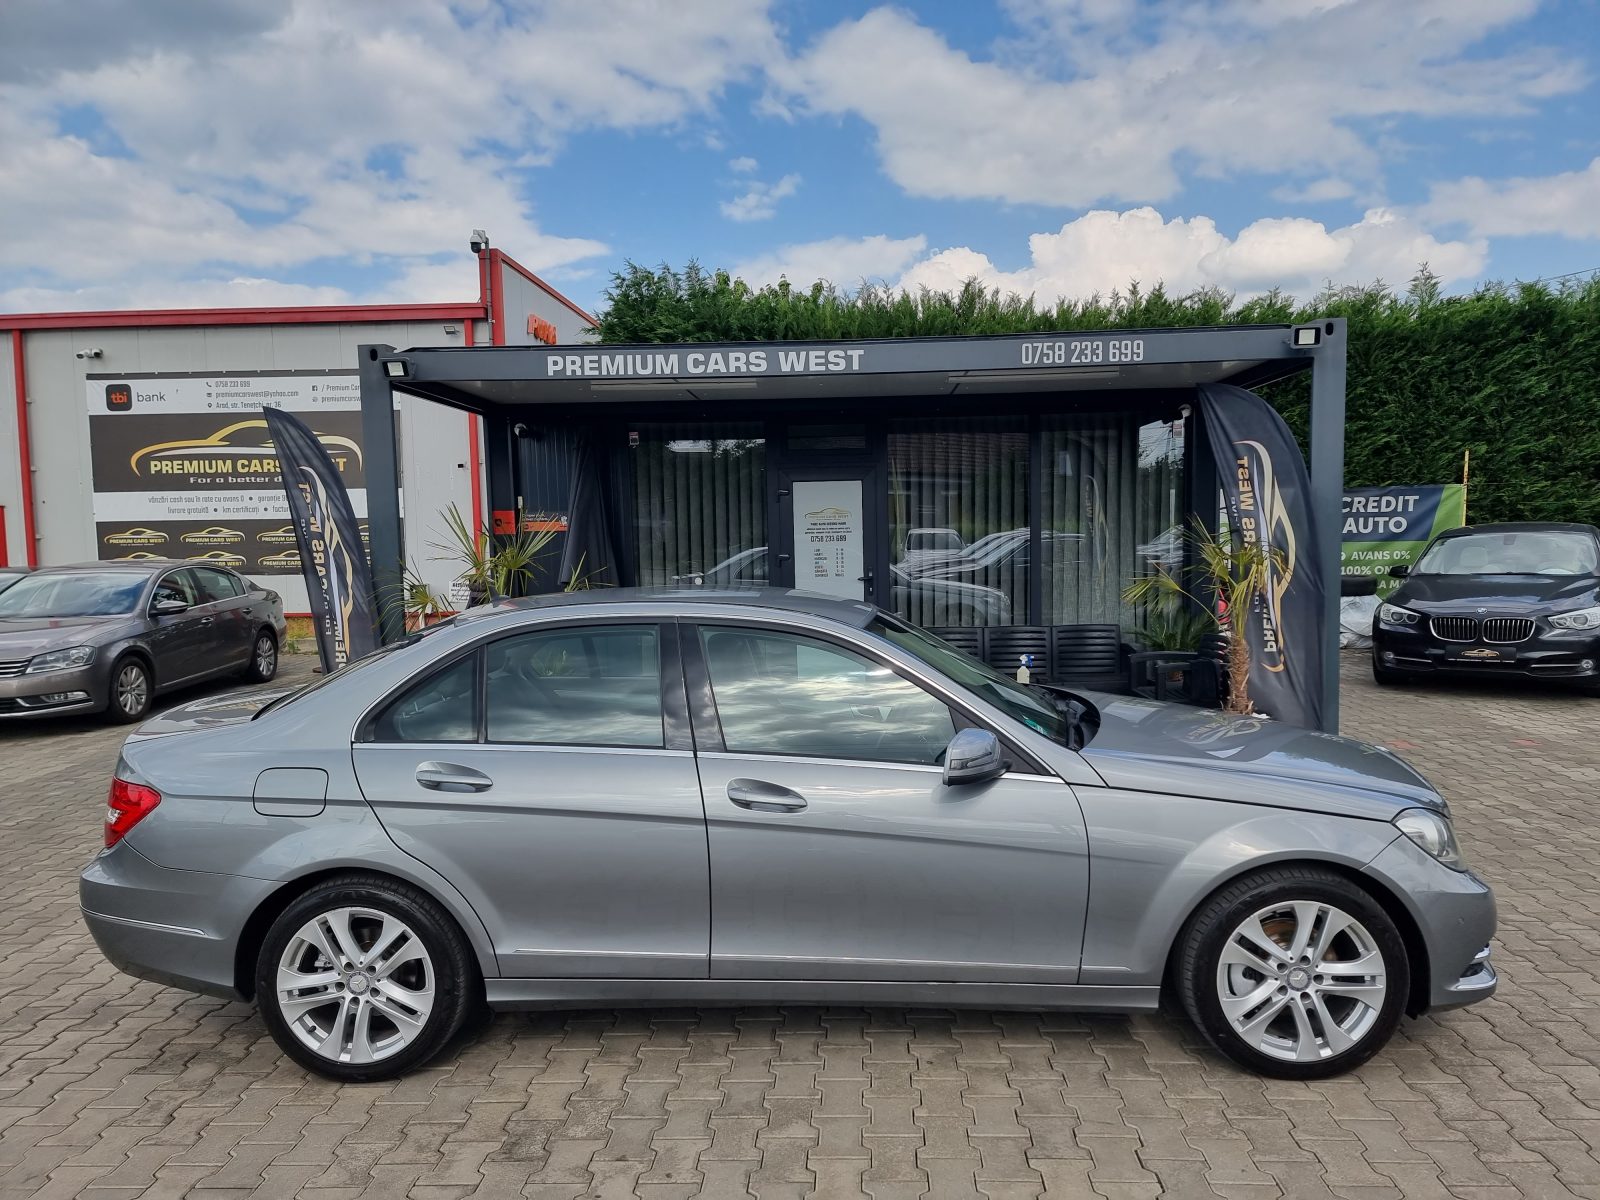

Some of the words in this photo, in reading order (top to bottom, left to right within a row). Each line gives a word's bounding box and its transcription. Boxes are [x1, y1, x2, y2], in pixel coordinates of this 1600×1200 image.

[1021, 342, 1065, 365] 0758
[1070, 341, 1103, 363] 233
[1109, 340, 1144, 362] 699
[547, 353, 679, 376] PREMIUM
[686, 351, 768, 374] CARS
[778, 349, 865, 372] WEST
[350, 383, 361, 391] Car
[110, 392, 128, 404] tbi
[136, 392, 167, 403] bank
[321, 394, 361, 404] premiumcarsw
[150, 459, 233, 475] PREMIUM
[189, 476, 213, 484] For
[228, 475, 271, 484] better
[272, 505, 289, 513] factur
[1341, 495, 1420, 513] CREDIT
[1342, 516, 1408, 534] AUTO
[1351, 551, 1391, 560] AVANS
[1393, 550, 1411, 560] 0%
[1340, 565, 1372, 575] 100%
